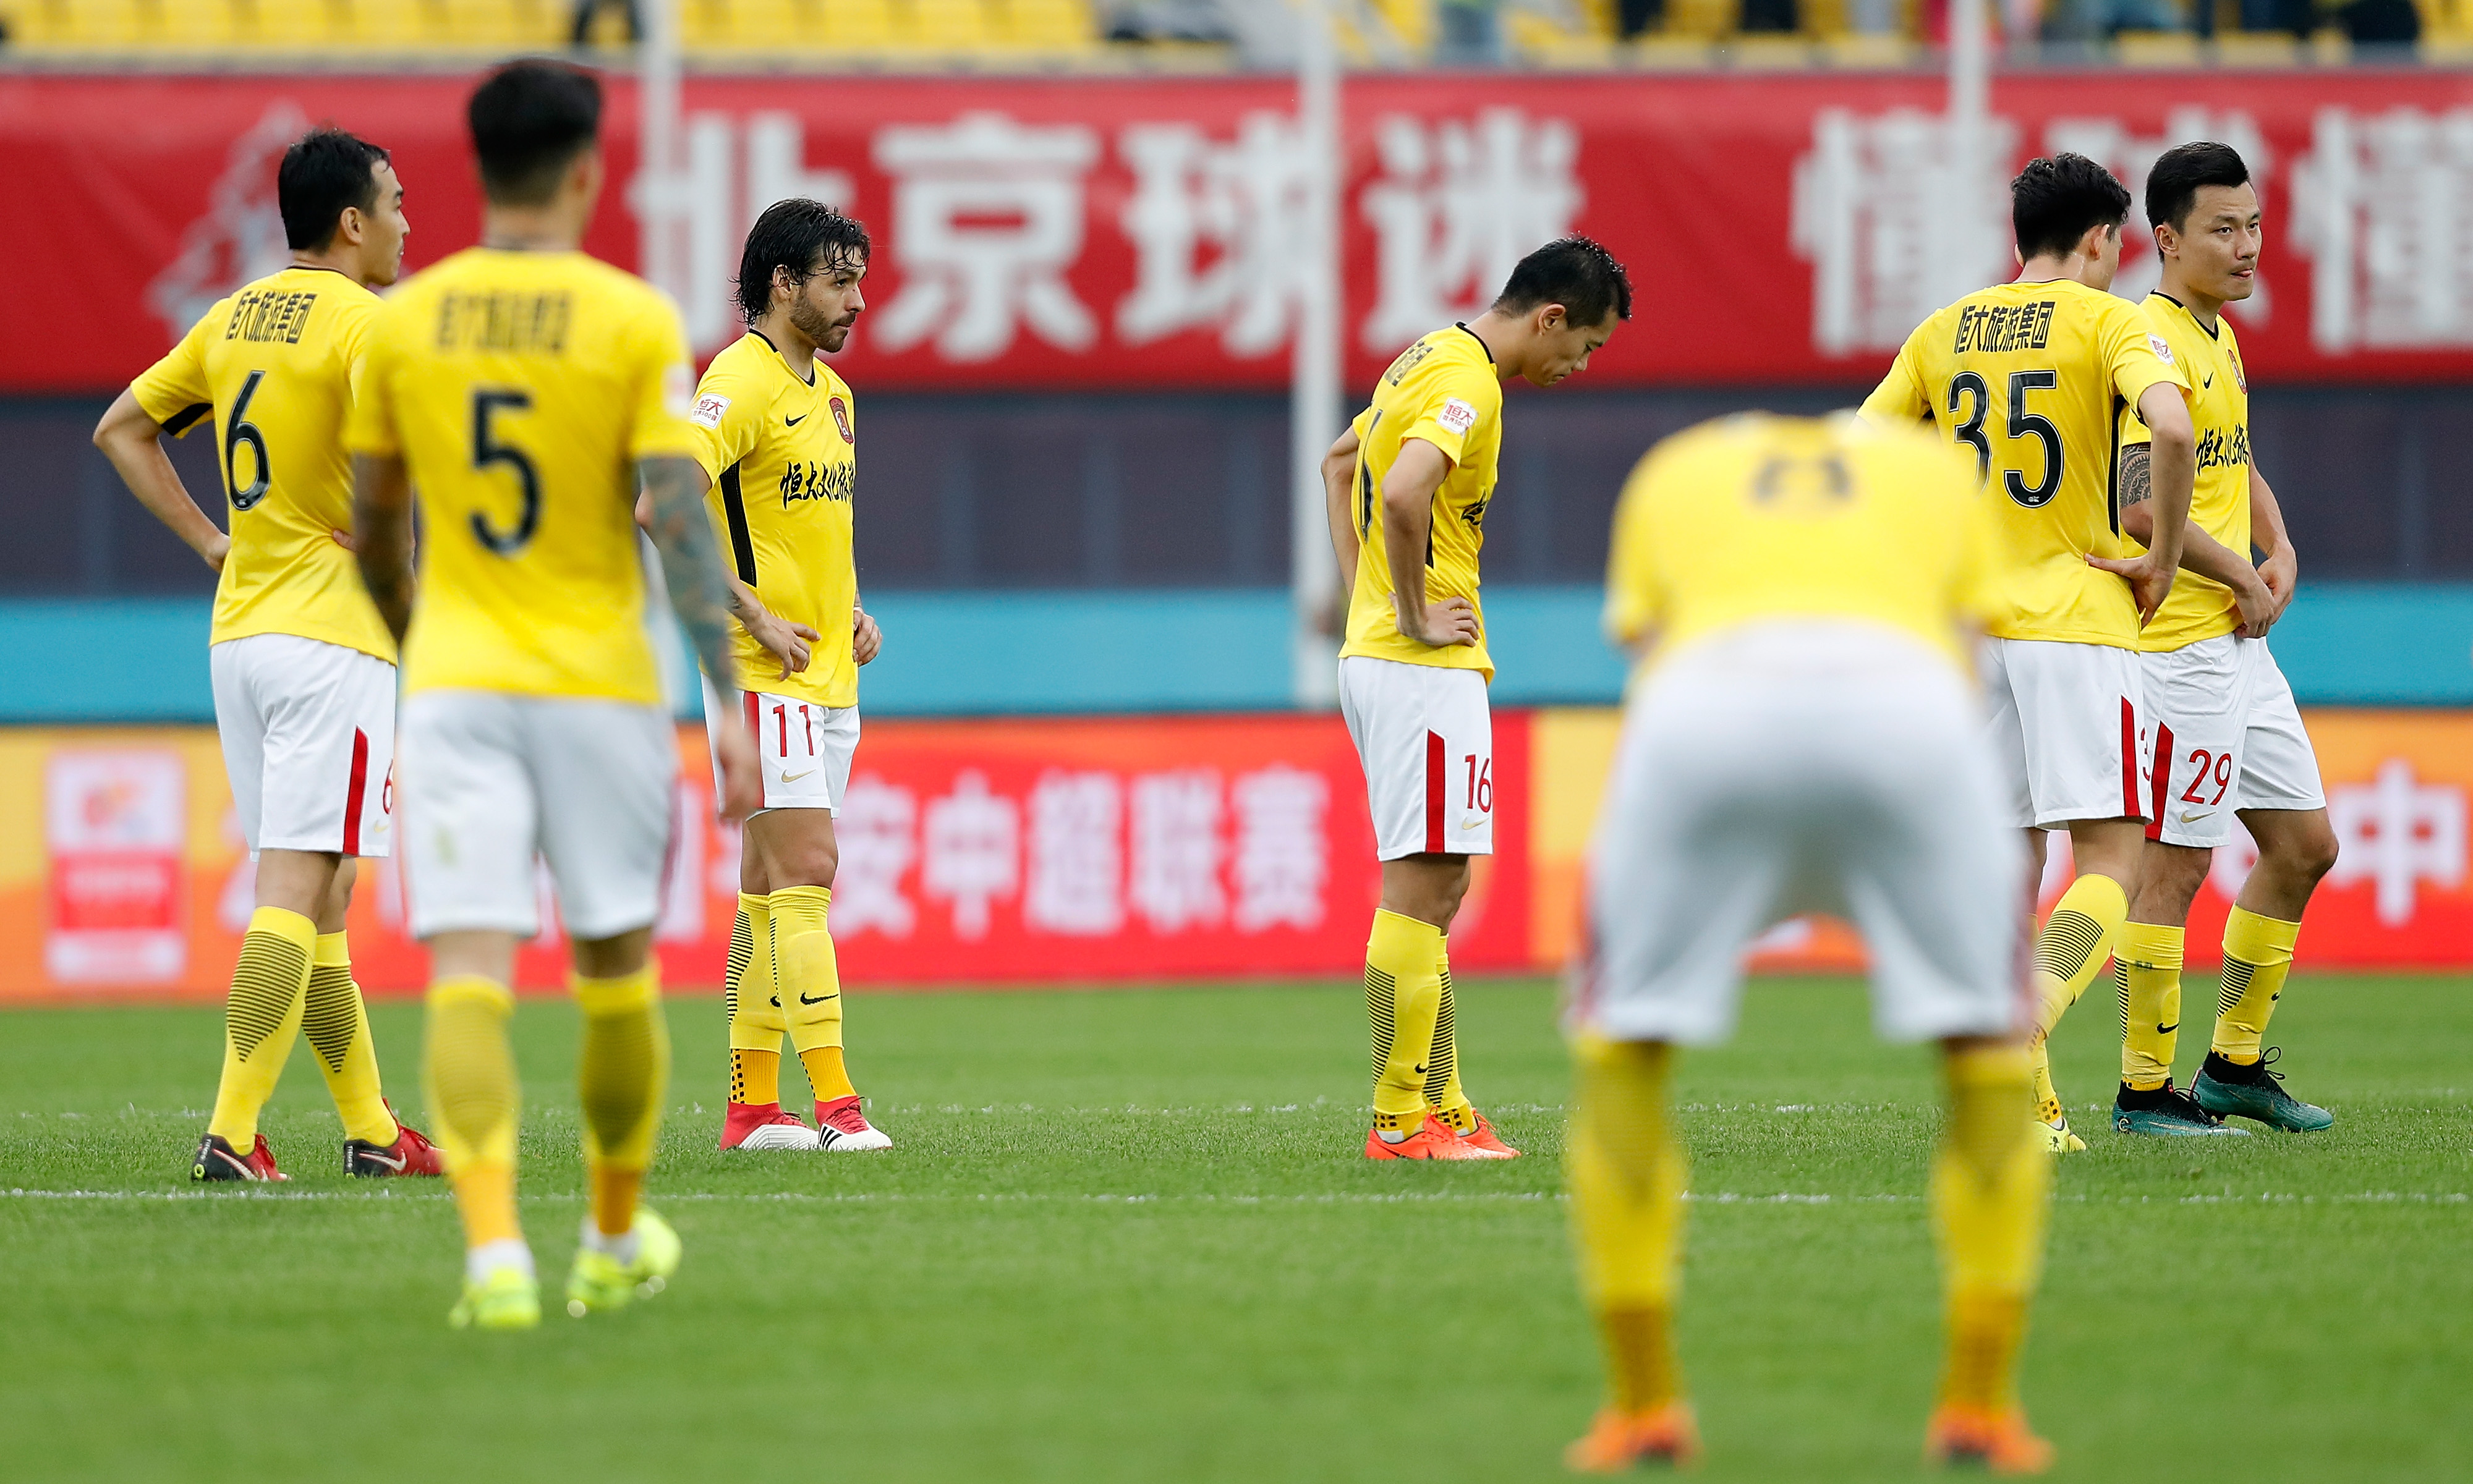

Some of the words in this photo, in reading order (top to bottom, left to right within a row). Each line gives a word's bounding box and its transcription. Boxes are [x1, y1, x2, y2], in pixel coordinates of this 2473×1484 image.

[624, 105, 1584, 363] 北京球迷
[1954, 301, 2056, 355] 恒大旅游集团
[697, 399, 723, 415] 恒大
[1445, 404, 1473, 425] 恒大
[225, 370, 271, 511] 6
[1947, 370, 2065, 509] 35
[471, 388, 539, 554] 5
[773, 703, 814, 757] 11
[1464, 753, 1492, 813] 16
[2180, 748, 2232, 806] 29
